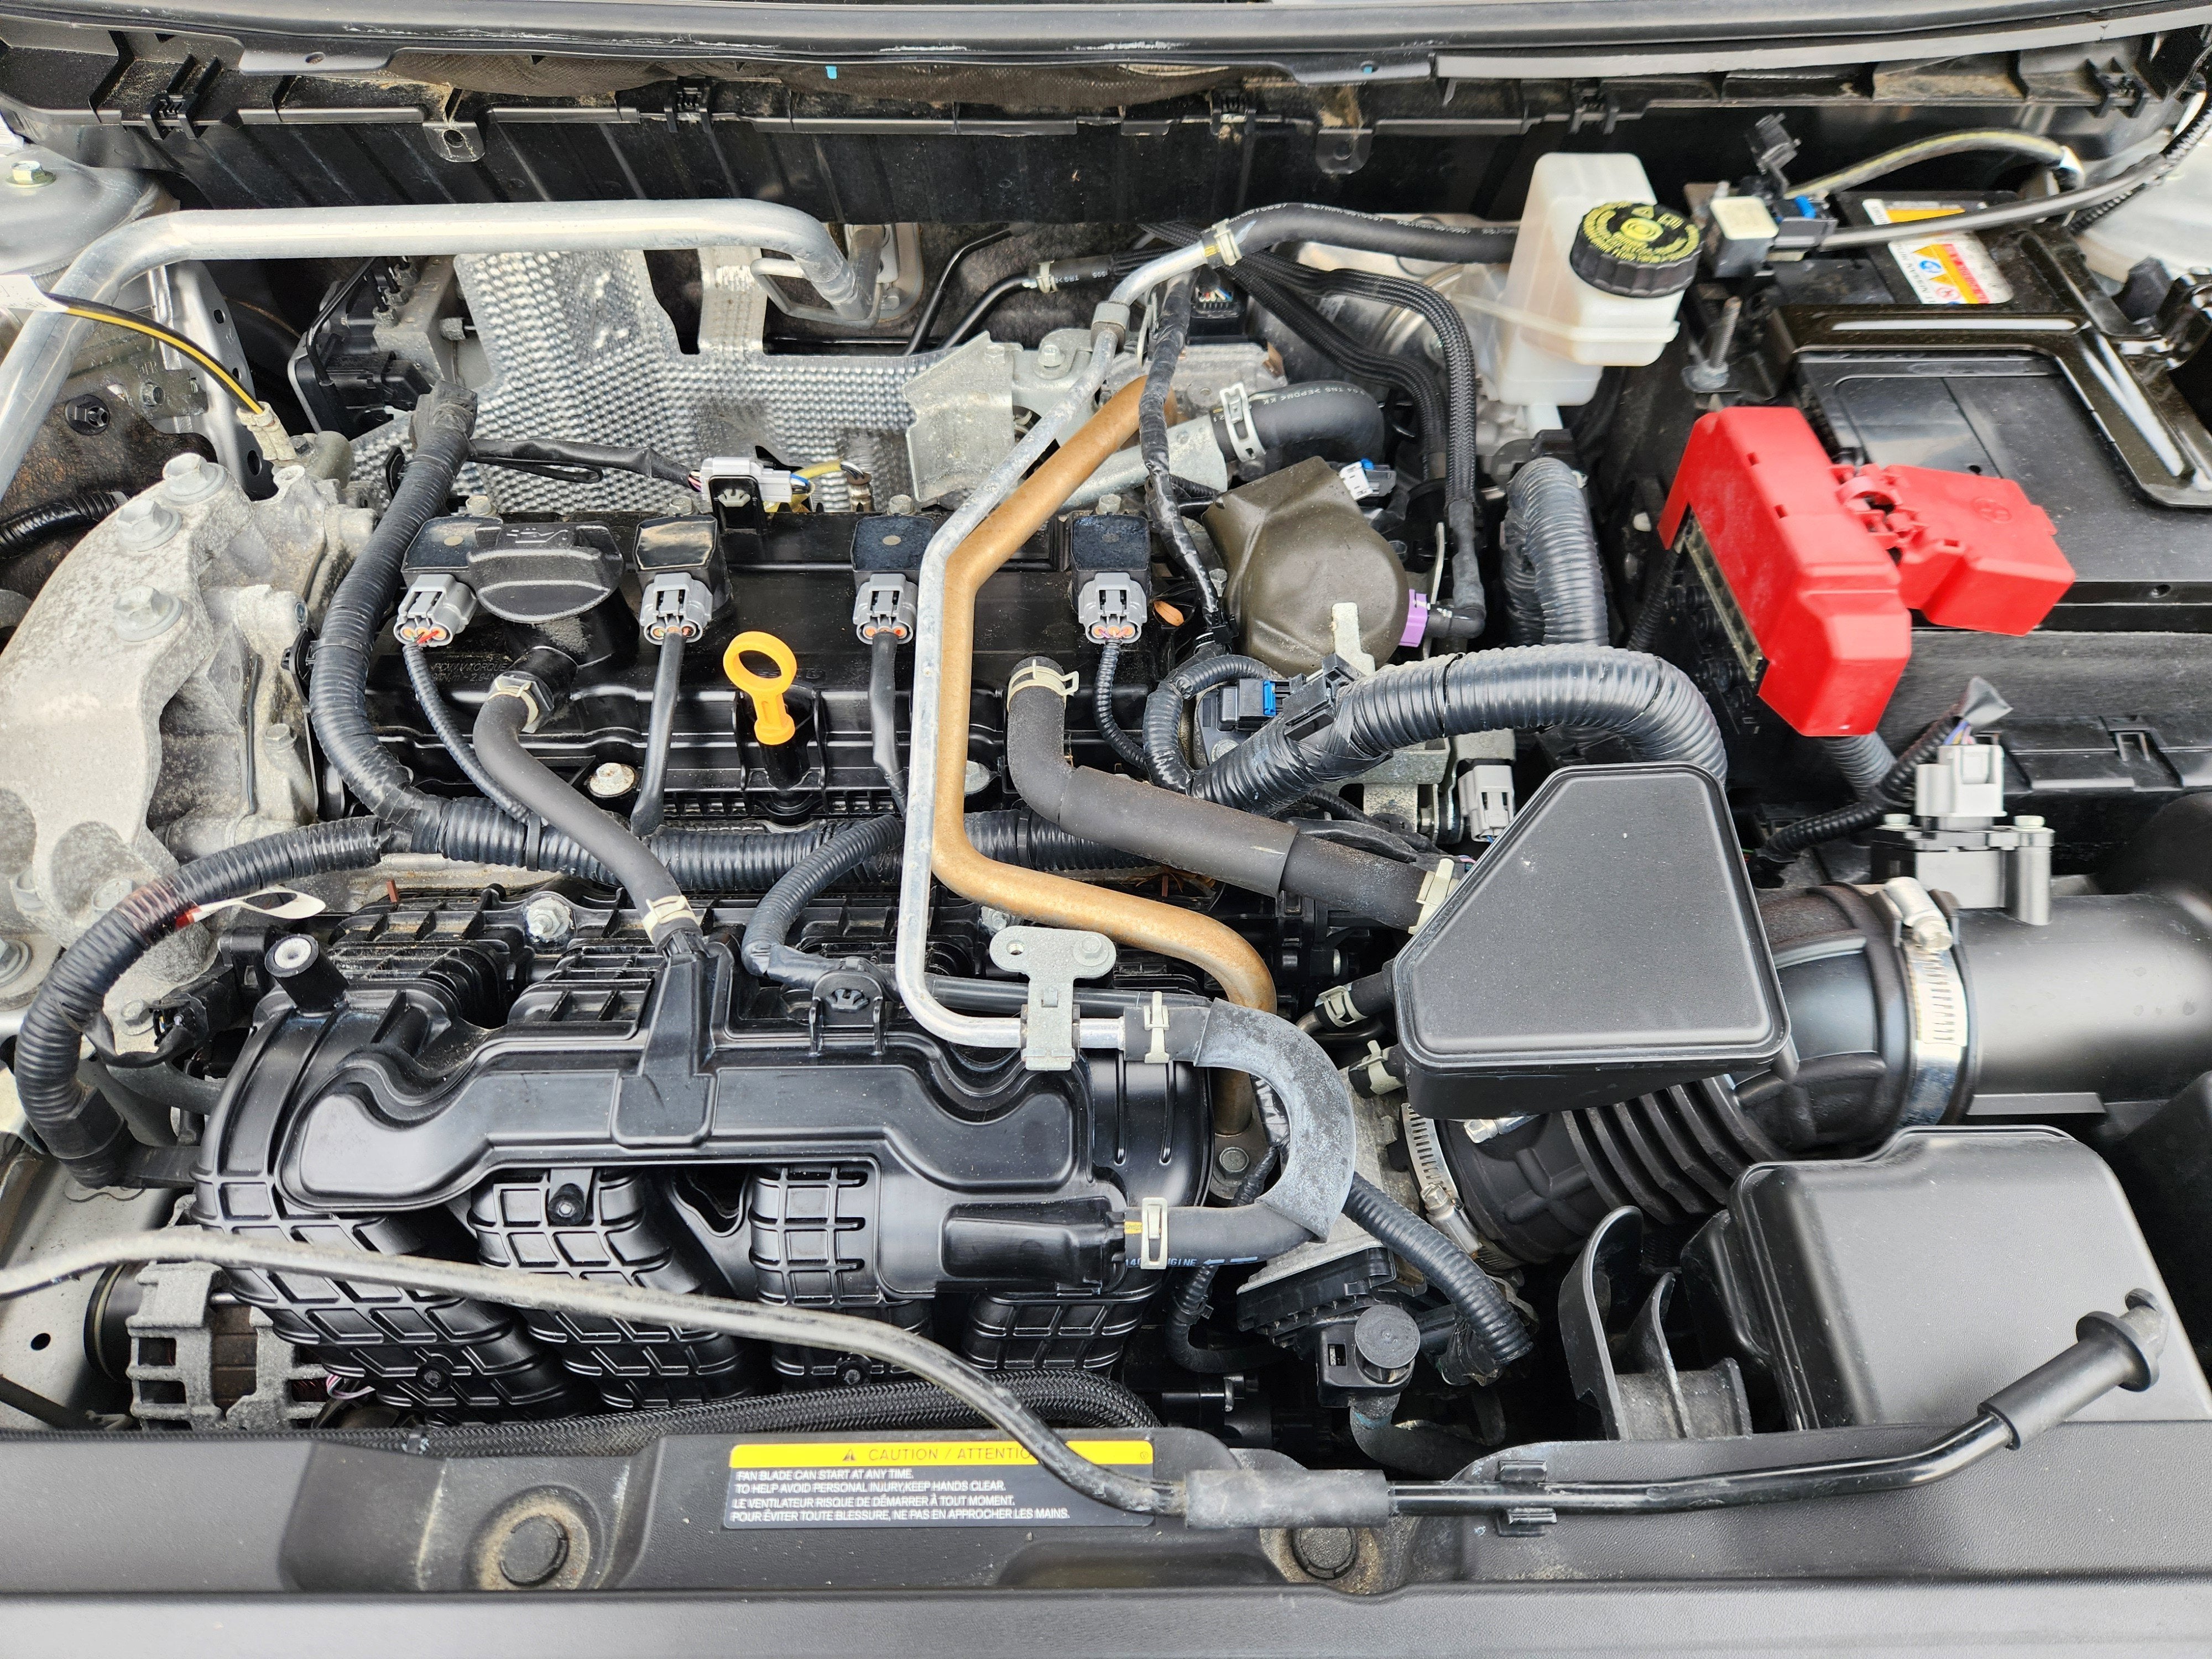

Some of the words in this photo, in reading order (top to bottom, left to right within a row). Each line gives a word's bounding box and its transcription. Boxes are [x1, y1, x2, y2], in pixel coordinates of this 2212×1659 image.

[869, 1448, 938, 1460] CAUTION
[944, 1448, 952, 1460] /
[957, 1447, 1031, 1459] ATTENTIO
[735, 1470, 758, 1481] FAN
[758, 1470, 793, 1480] BLADE
[794, 1469, 817, 1480] CAN
[817, 1469, 851, 1480] START
[851, 1468, 864, 1479] AT
[864, 1468, 887, 1479] ANY
[734, 1483, 750, 1494] TO
[752, 1482, 779, 1493] HELP
[779, 1482, 811, 1493] AVOID
[812, 1481, 868, 1493] PERSONAL
[931, 1480, 968, 1491] HANDS
[969, 1480, 1006, 1491] CLEAR.
[732, 1498, 747, 1509] LE
[747, 1497, 814, 1509] VENTILATEUR
[815, 1496, 854, 1507] RISQUE
[855, 1496, 871, 1507] DE
[872, 1493, 929, 1507] DÉMARRER
[929, 1493, 938, 1506] À
[938, 1495, 967, 1506] TOUT
[968, 1495, 1015, 1506] MOMENT.
[730, 1511, 763, 1522] POUR
[763, 1508, 799, 1521] ÉVITER
[799, 1510, 833, 1521] TOUTE
[834, 1509, 891, 1521] BLESSURE,
[891, 1509, 907, 1520] NE
[910, 1509, 930, 1520] PAS
[930, 1509, 947, 1519] EN
[946, 1508, 1013, 1519] APPROCHER
[1013, 1507, 1034, 1519] LES
[1034, 1507, 1070, 1519] MAINS.
